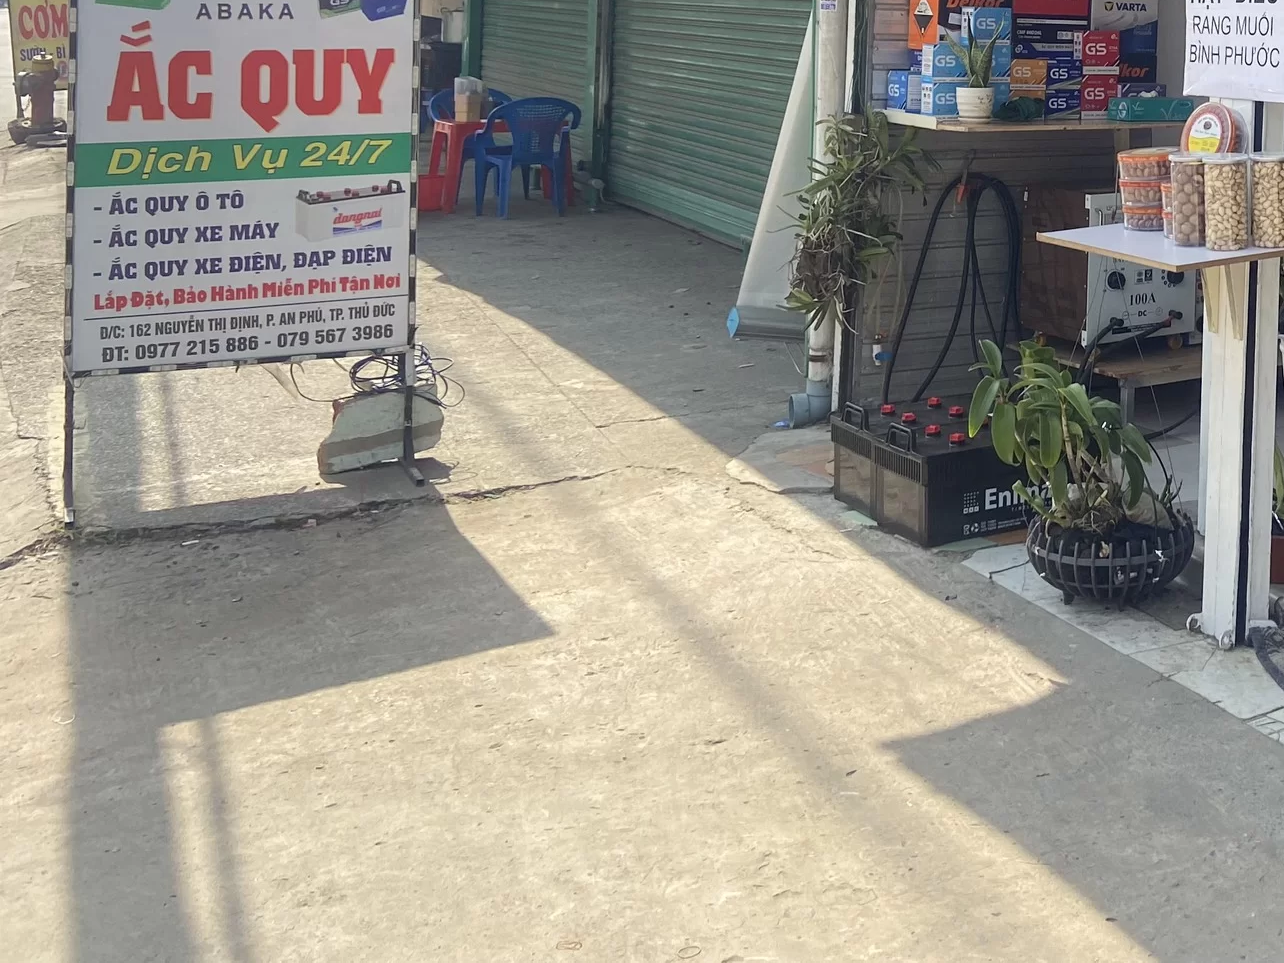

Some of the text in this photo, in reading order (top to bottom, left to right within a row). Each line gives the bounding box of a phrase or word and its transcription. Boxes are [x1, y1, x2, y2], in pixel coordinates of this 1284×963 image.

[195, 3, 294, 21] ABAKA
[1115, 2, 1147, 12] VARTA
[1192, 11, 1274, 37] RANG MUỐI
[935, 55, 956, 67] GS
[1085, 43, 1106, 55] GS
[1189, 41, 1280, 68] BÌNH PHƯỚC
[107, 20, 395, 133] ẮC QUY
[1013, 66, 1031, 77] GS
[1084, 88, 1105, 100] GS
[106, 140, 393, 181] Dịch Vụ 24/7
[109, 189, 244, 216] ẮC QUY Ô TÔ
[109, 220, 280, 248] ẮC QUY XE MÁY
[109, 244, 393, 281] ẮC QUY XE ĐIỆN, ĐẠP ĐIỆN
[94, 291, 127, 312] Lắp
[130, 290, 169, 309] Đặt,
[173, 286, 207, 305] Bảo
[211, 284, 258, 302] Hành
[262, 278, 304, 298] Miễn
[339, 276, 370, 294] Tận
[373, 273, 400, 290] Nơi
[1130, 292, 1156, 306] 100A
[100, 301, 395, 340] Đ/C: 162 NGUYỄN THỊ ĐỊNH, P. AN PHÚ, TP. THỦ ĐỨC
[102, 346, 129, 363] ĐT:
[135, 342, 180, 360] 0977
[186, 339, 220, 356] 215
[226, 336, 258, 353] 886
[277, 331, 309, 348] 079
[315, 327, 346, 345] 567
[352, 324, 394, 341] 3986
